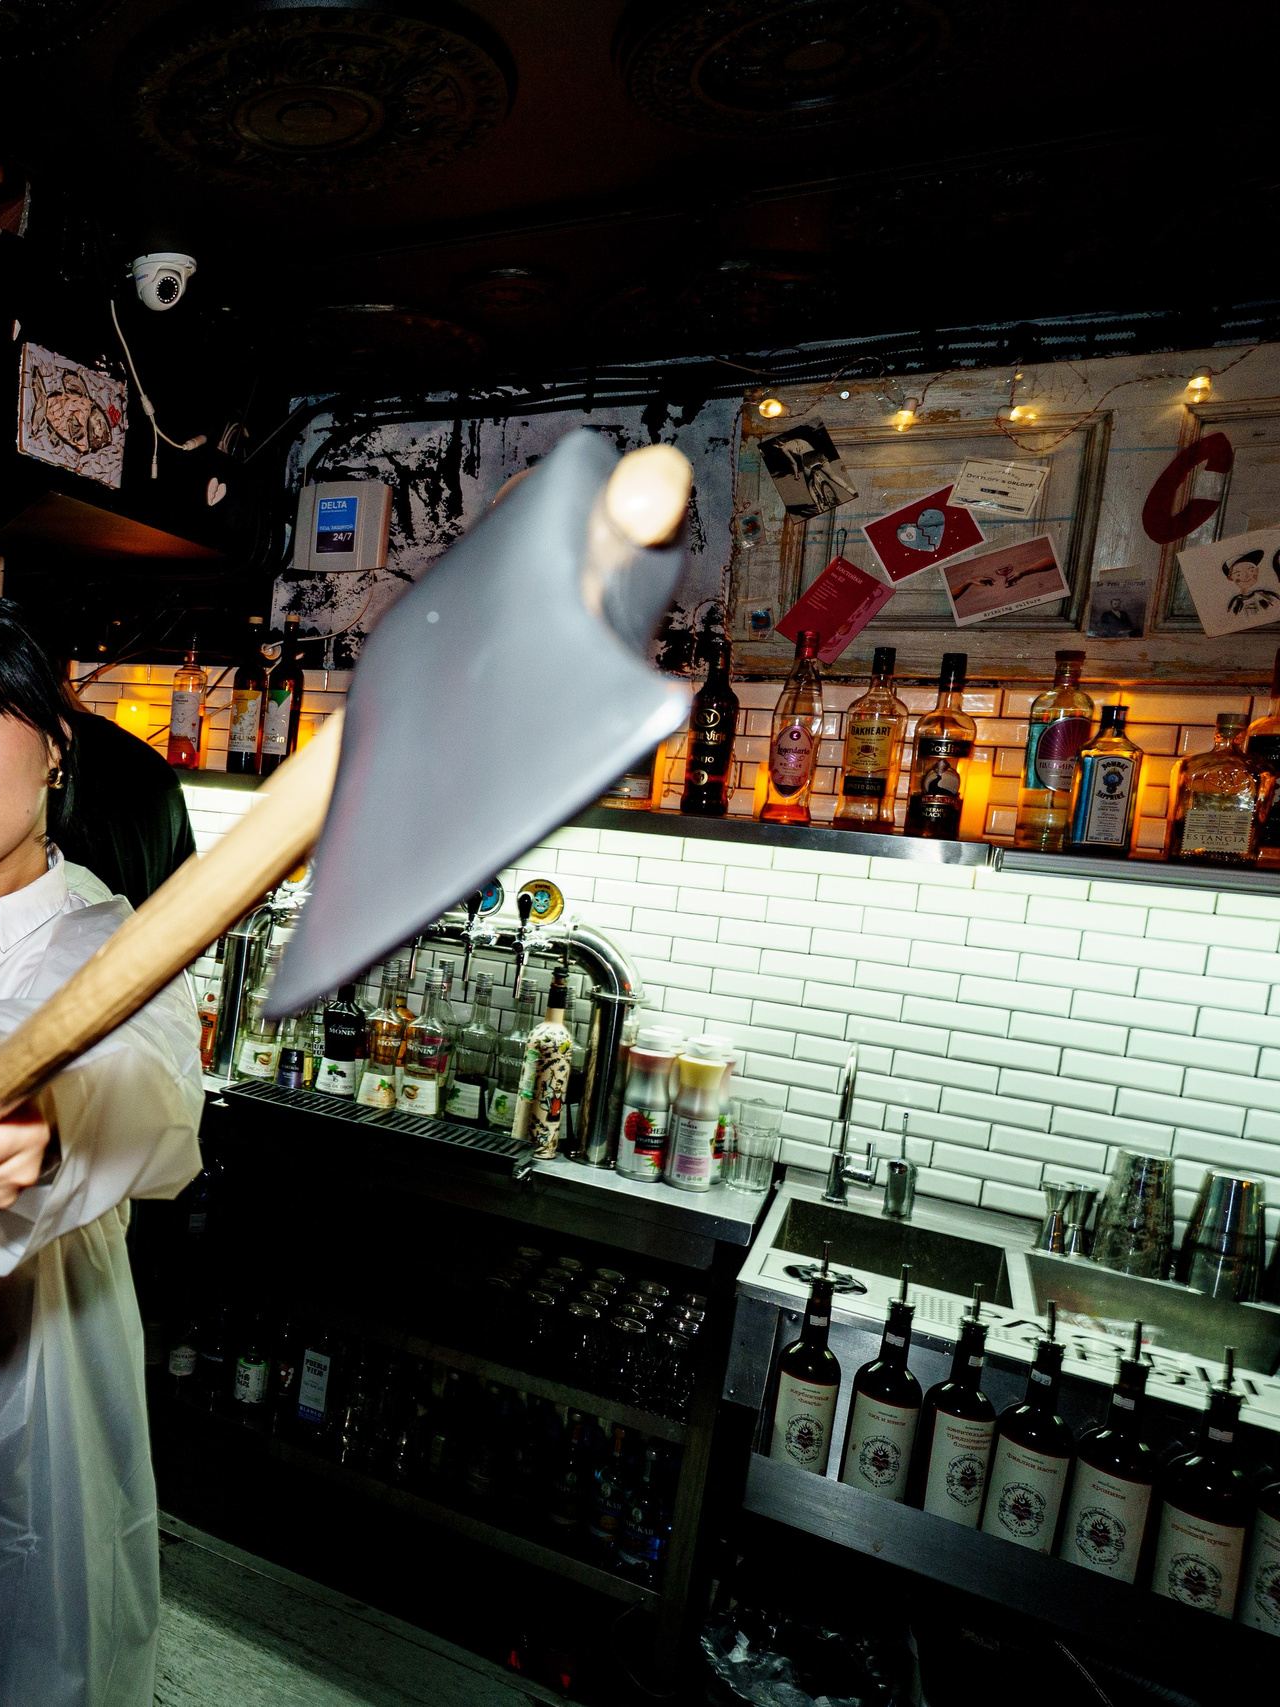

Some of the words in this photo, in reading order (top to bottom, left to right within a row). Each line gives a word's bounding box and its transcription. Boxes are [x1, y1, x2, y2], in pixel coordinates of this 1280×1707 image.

[321, 500, 348, 510] DELTA
[332, 532, 353, 541] 24/7
[983, 605, 1013, 618] drinking
[1015, 598, 1041, 609] culture
[850, 725, 892, 737] OAKHEART
[777, 743, 811, 756] Legendario
[1101, 761, 1129, 772] BOMBAY
[1186, 834, 1246, 843] ESTANCIA
[328, 1026, 356, 1036] MONIN
[305, 1358, 328, 1372] PUEBLO
[306, 1366, 324, 1378] VIEJO
